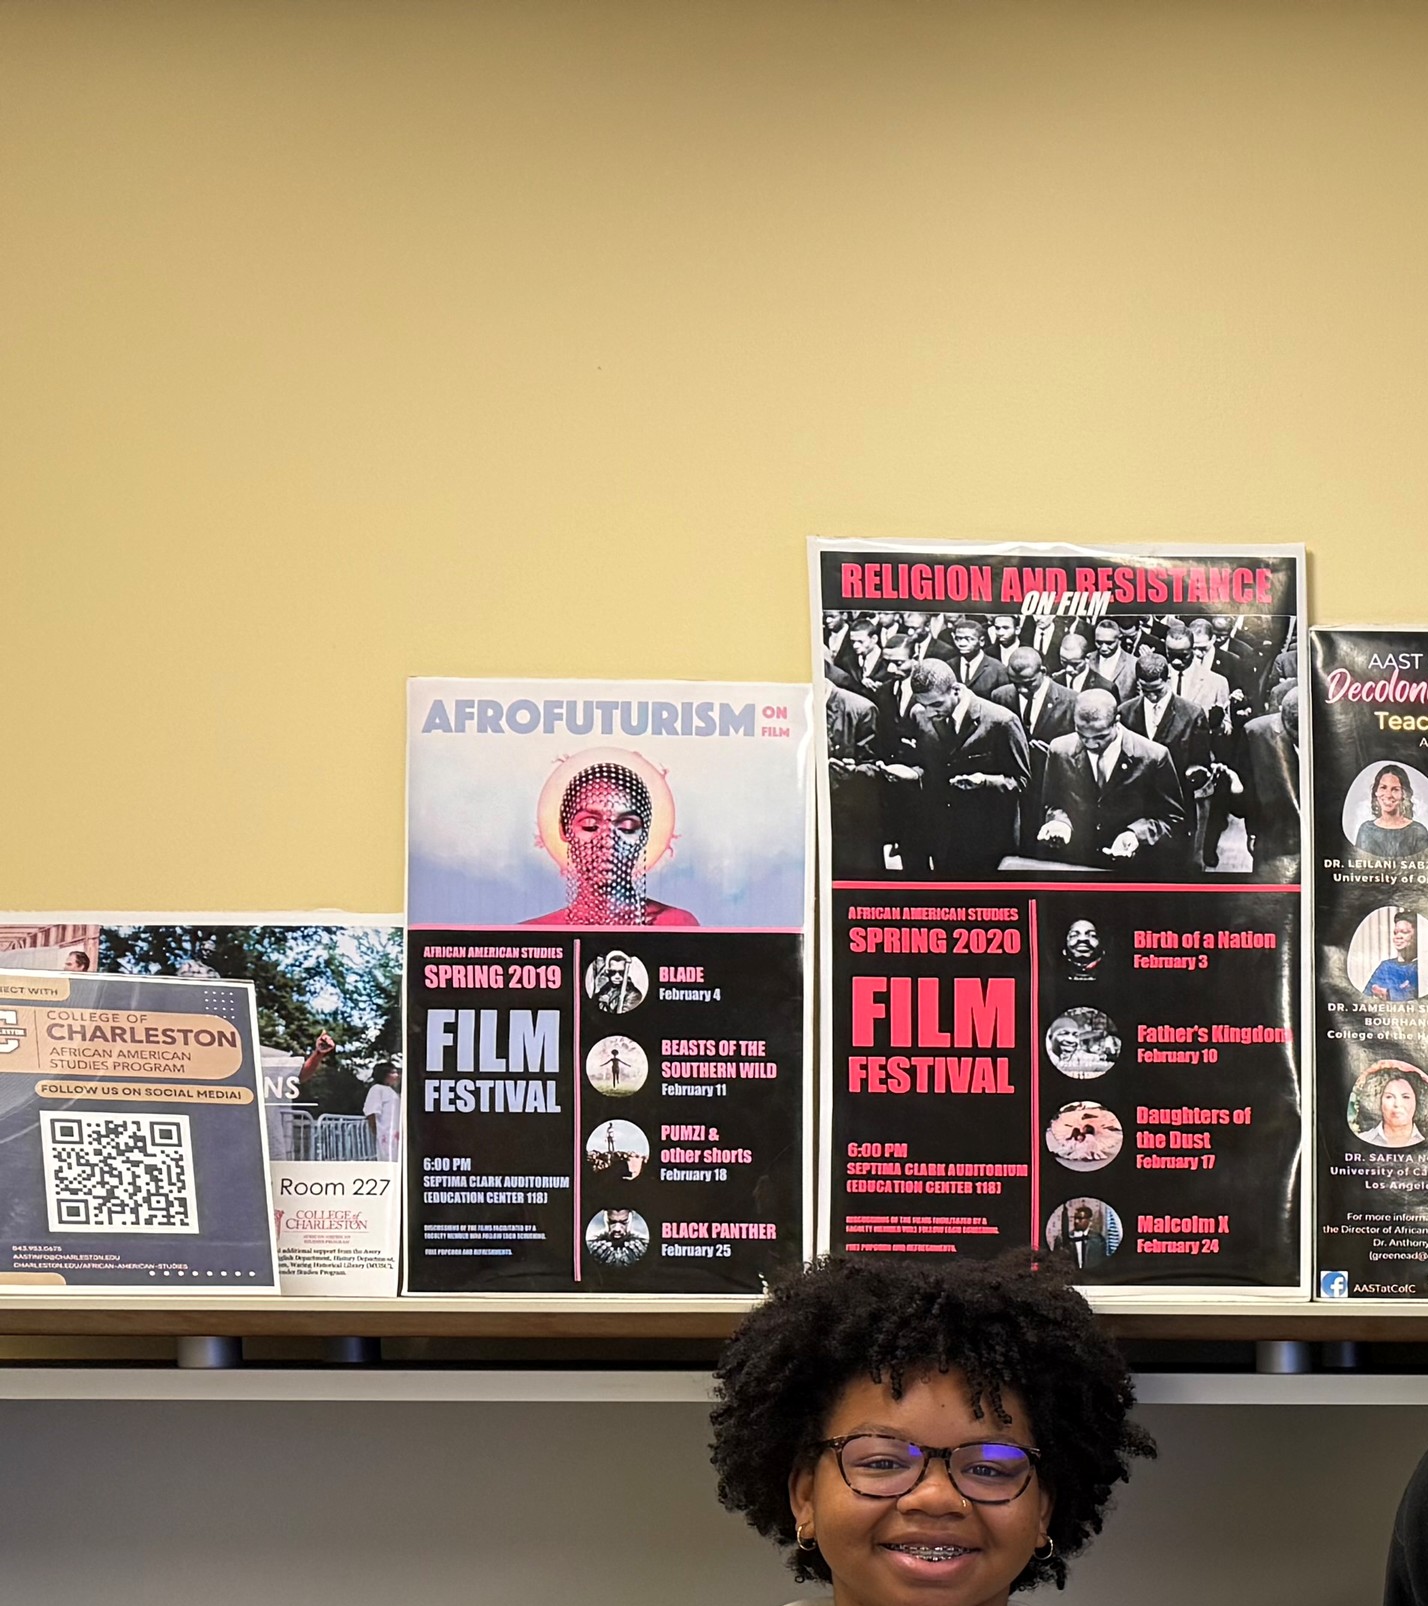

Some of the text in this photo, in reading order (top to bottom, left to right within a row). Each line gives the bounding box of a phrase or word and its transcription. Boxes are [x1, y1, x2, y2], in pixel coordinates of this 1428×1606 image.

[841, 560, 1273, 604] RELIGION AND RESISTANCE
[1019, 590, 1112, 617] ON FILM
[1368, 653, 1423, 672] AAST
[421, 698, 755, 736] AFROFUTURISM
[762, 706, 787, 719] ON
[761, 726, 789, 737] FILM
[849, 927, 1020, 953] SPRING 2020
[425, 964, 560, 988] SPRING 2019
[659, 966, 704, 982] BLADE
[47, 1010, 147, 1023] COLLEGE OF
[852, 976, 1015, 1047] FILM
[46, 1022, 239, 1047] CHARLESTON
[426, 1009, 559, 1072] FILM
[49, 1046, 190, 1061] AFRICAN AMERICAN
[50, 1059, 184, 1072] STUDIES PROGRAM
[848, 1056, 1014, 1093] FESTIVAL
[41, 1084, 97, 1094] FOLLOW
[101, 1086, 118, 1094] US
[122, 1087, 140, 1095] ON
[145, 1088, 193, 1097] SOCIAL
[425, 1079, 560, 1112] FESTIVAL
[280, 1178, 390, 1195] Room 227
[662, 1222, 776, 1239] BLACK PANTHER
[1137, 1215, 1229, 1233] Malcolm X
